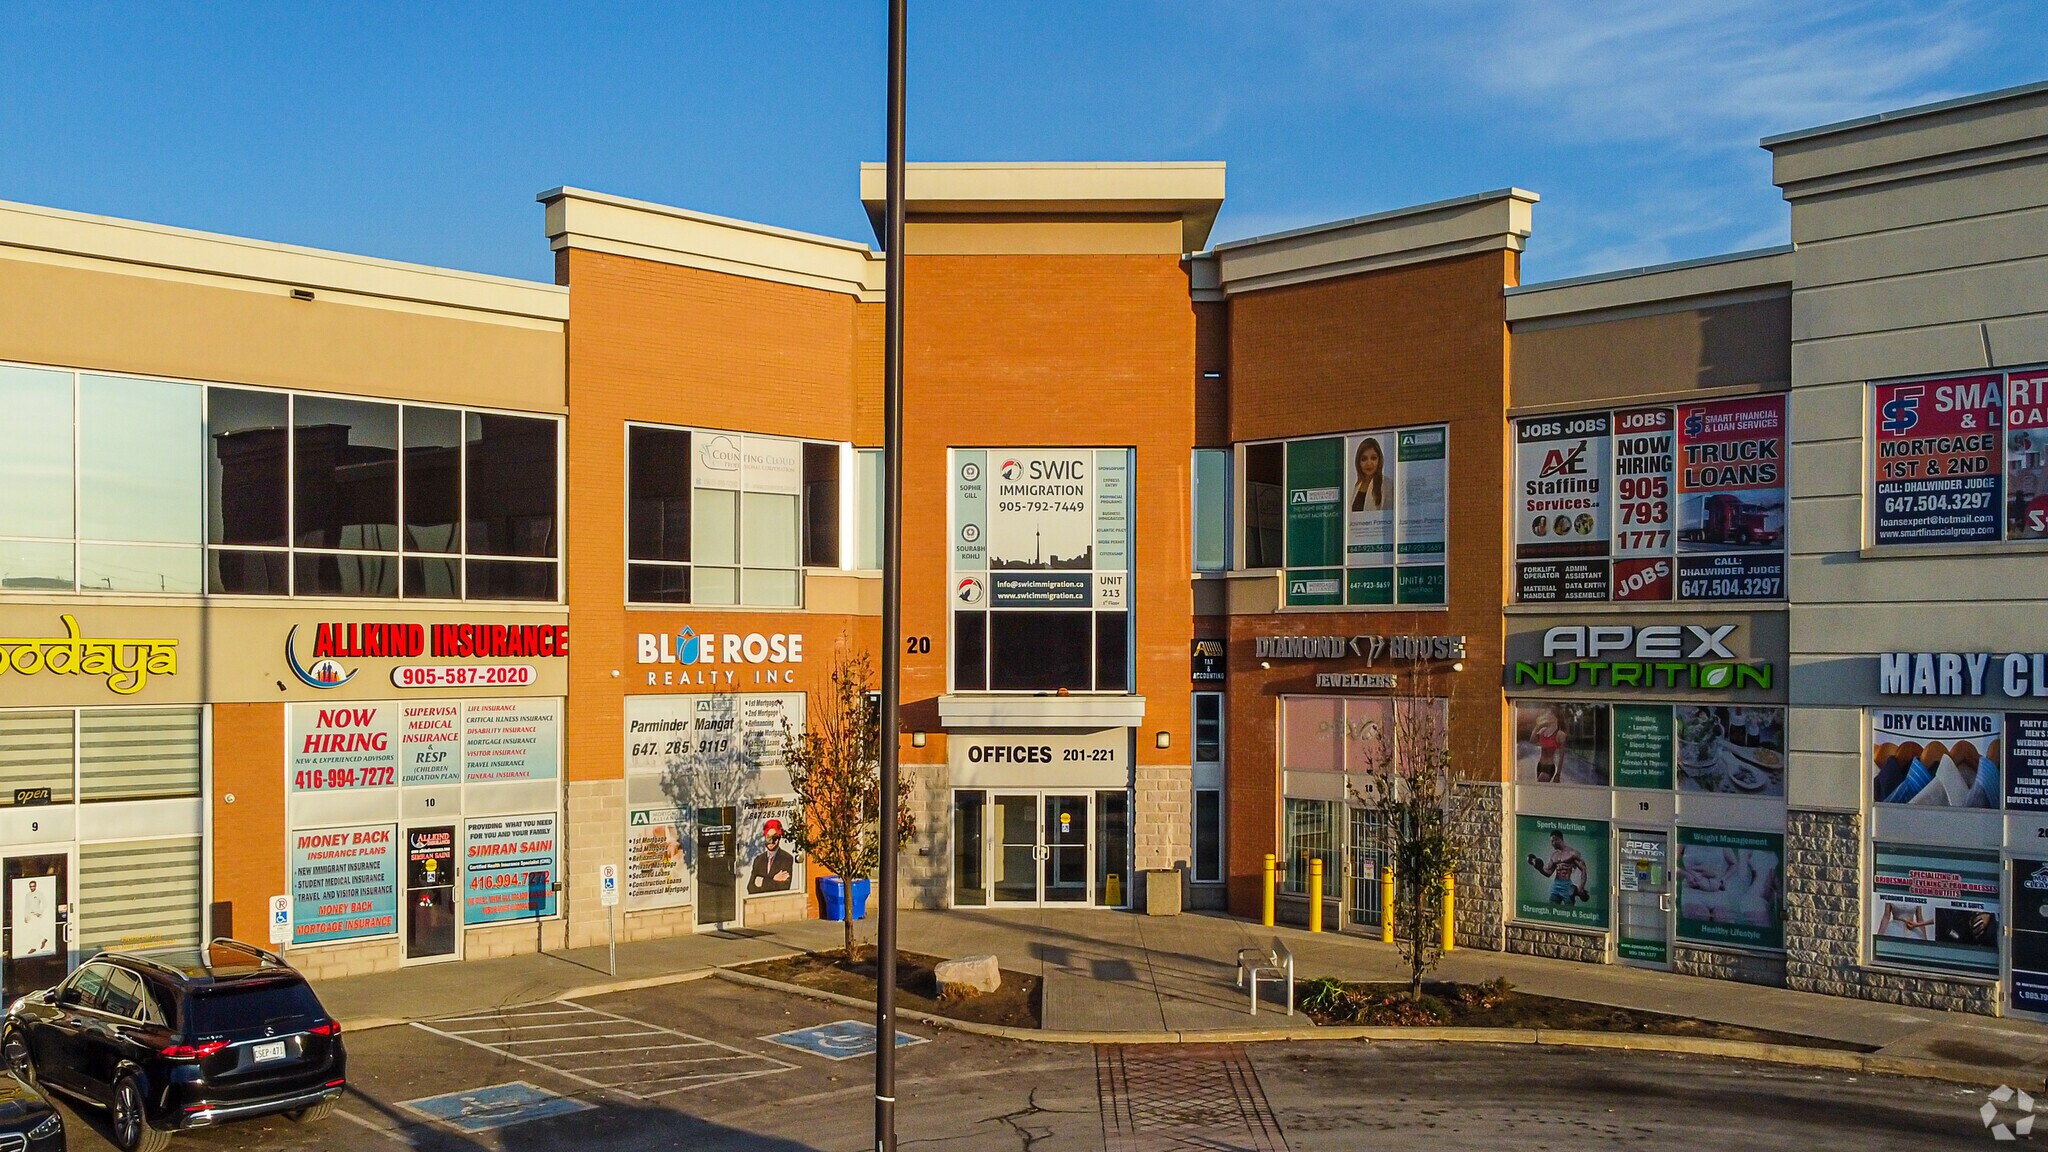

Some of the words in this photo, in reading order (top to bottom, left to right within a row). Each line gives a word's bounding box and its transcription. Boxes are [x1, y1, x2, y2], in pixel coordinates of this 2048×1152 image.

[1622, 412, 1666, 428] JOBS
[1705, 414, 1734, 424] SMART
[1734, 409, 1778, 421] FINANCIAL
[1960, 413, 1976, 428] &
[1522, 420, 1562, 438] JOBS
[1565, 418, 1606, 435] JOBS
[1705, 424, 1712, 432] &
[1712, 422, 1736, 432] LOAN
[1736, 418, 1778, 430] SERVICES
[1616, 435, 1671, 456] NOW
[1684, 438, 1778, 465] TRUCK
[1880, 434, 1994, 458] MORTGAGE
[766, 455, 795, 466] CLOUD
[1616, 454, 1672, 476] HIRING
[1883, 461, 1920, 478] 1ST
[1926, 459, 1940, 476] &
[1948, 456, 1989, 474] 2ND
[1029, 460, 1084, 480] SWIC
[1684, 462, 1777, 488] LOANS
[1000, 485, 1084, 496] IMMIGRATION
[1526, 478, 1600, 496] Staffing
[1619, 476, 1668, 500] 905
[1878, 482, 1902, 494] CALL:
[1904, 480, 1962, 492] DHALWINDER
[1964, 478, 1994, 489] JUDGE
[999, 502, 1084, 512] 905-792-7449
[1526, 498, 1600, 512] Services.ca
[1885, 492, 1992, 513] 647.504.3297
[1619, 501, 1669, 525] 793
[1880, 515, 1994, 527] loansexpert@hotmail.com
[1617, 530, 1671, 550] 1777
[1879, 527, 1994, 538] www.smartfinancialgroup.com
[1714, 557, 1742, 566] CALL:
[1618, 560, 1670, 597] JOBS
[1680, 566, 1745, 577] DHALWINDER
[1746, 565, 1781, 575] JUDGE
[997, 580, 1084, 589] info@swicimmigration.ca
[1100, 576, 1122, 586] UNIT
[1400, 576, 1424, 586] UNIT#
[1427, 575, 1443, 584] 212
[1682, 577, 1780, 598] 647.504.3297
[997, 592, 1084, 600] www.swicimmigration.ca
[1102, 588, 1120, 597] 213
[314, 622, 424, 658] ALLKIND
[431, 624, 569, 658] INSURANCE
[636, 627, 714, 664] BLUE
[722, 633, 803, 664] ROSE
[906, 636, 930, 654] 20
[1256, 636, 1346, 658] DIAMOND
[1390, 636, 1466, 659] HOUSE
[1542, 624, 1738, 659] APEX
[0, 614, 178, 694] odaya
[402, 666, 528, 685] 905-587-2020
[647, 670, 735, 686] REALTY
[754, 669, 794, 684] INC
[1316, 673, 1398, 688] JEWELLERS
[1514, 662, 1772, 689] NUTRITION
[1880, 653, 1988, 696] MARY
[316, 708, 378, 728] NOW
[404, 706, 458, 717] SUPERVISA
[408, 720, 453, 730] MEDICAL
[630, 718, 689, 733] Parminder
[694, 717, 734, 732] Mangat
[1883, 714, 1914, 730] DRY
[1916, 714, 1992, 733] CLEANING
[302, 732, 388, 754] HIRING
[402, 732, 459, 743] INSURANCE
[632, 742, 658, 756] 647.
[664, 740, 690, 755] 285
[694, 740, 728, 754] .9119
[968, 746, 1052, 764] OFFICES
[1062, 748, 1115, 762] 201-221
[319, 756, 362, 764] EXPERIENCED
[363, 754, 394, 762] ADVISORS
[416, 751, 448, 764] RESP
[294, 766, 395, 790] 416-994-7272
[402, 774, 440, 782] EDUCATION
[440, 773, 460, 782] PLAN)
[713, 782, 721, 790] 11
[16, 788, 49, 804] open
[424, 798, 436, 808] 10
[1638, 801, 1650, 811] 19
[32, 822, 39, 832] 9
[468, 822, 503, 831] PROVIDING
[1536, 820, 1557, 831] Sports
[1558, 821, 1586, 832] Nutrition
[297, 832, 350, 850] MONEY
[352, 830, 390, 845] BACK
[1626, 840, 1660, 850] APEX
[1693, 832, 1719, 845] Weight
[1719, 834, 1768, 848] Management
[307, 849, 358, 860] INSURANCE
[358, 846, 386, 856] PLANS
[468, 842, 518, 858] SIMRAN
[520, 840, 553, 853] SAINI
[1621, 848, 1665, 857] NUTRITION
[470, 870, 550, 889] 416.994.7272
[1910, 870, 1951, 880] SPECIALIZING
[632, 880, 666, 888] Construction
[632, 888, 664, 897] Commercial
[665, 885, 689, 894] Mortgage
[318, 904, 349, 916] MONEY
[351, 900, 373, 912] BACK
[1522, 904, 1551, 917] Strength,
[1552, 907, 1571, 920] Pump
[1571, 910, 1578, 918] &
[1579, 910, 1600, 922] Sculpt
[296, 921, 343, 935] MORTGAGE
[345, 916, 392, 930] INSURANCE
[272, 1046, 283, 1055] 471
